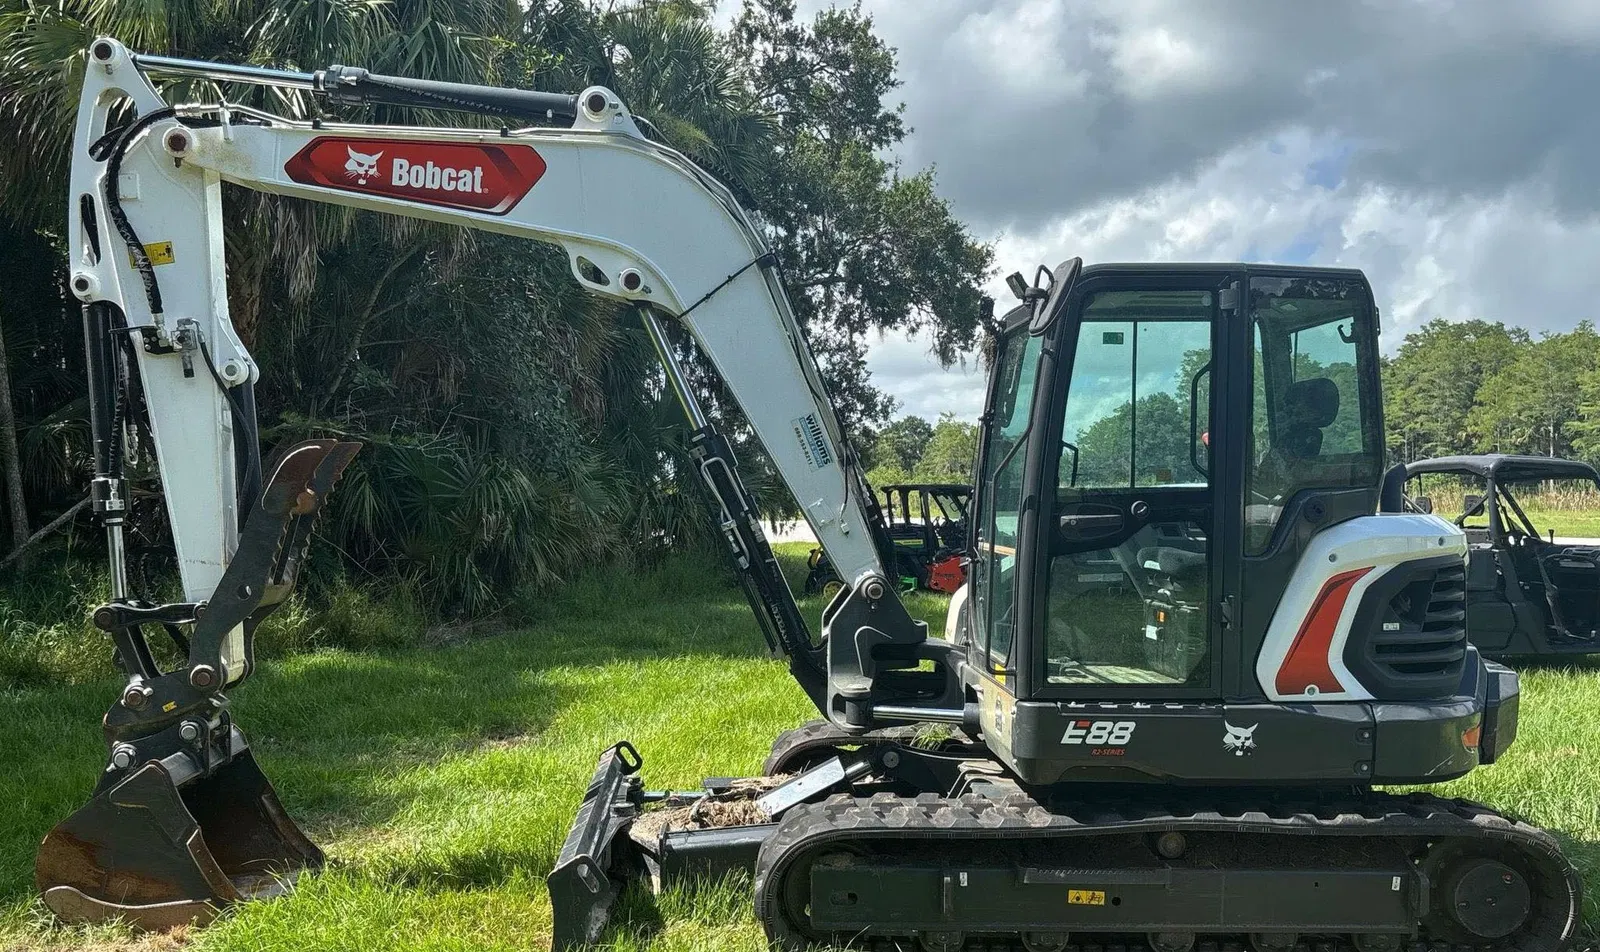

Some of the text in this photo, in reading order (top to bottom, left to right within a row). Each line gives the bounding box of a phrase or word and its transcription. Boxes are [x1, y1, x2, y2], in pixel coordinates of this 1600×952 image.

[391, 157, 484, 194] Bobcat
[805, 414, 831, 465] williams
[1060, 720, 1137, 745] E88
[1091, 748, 1126, 756] R2-SERIES
